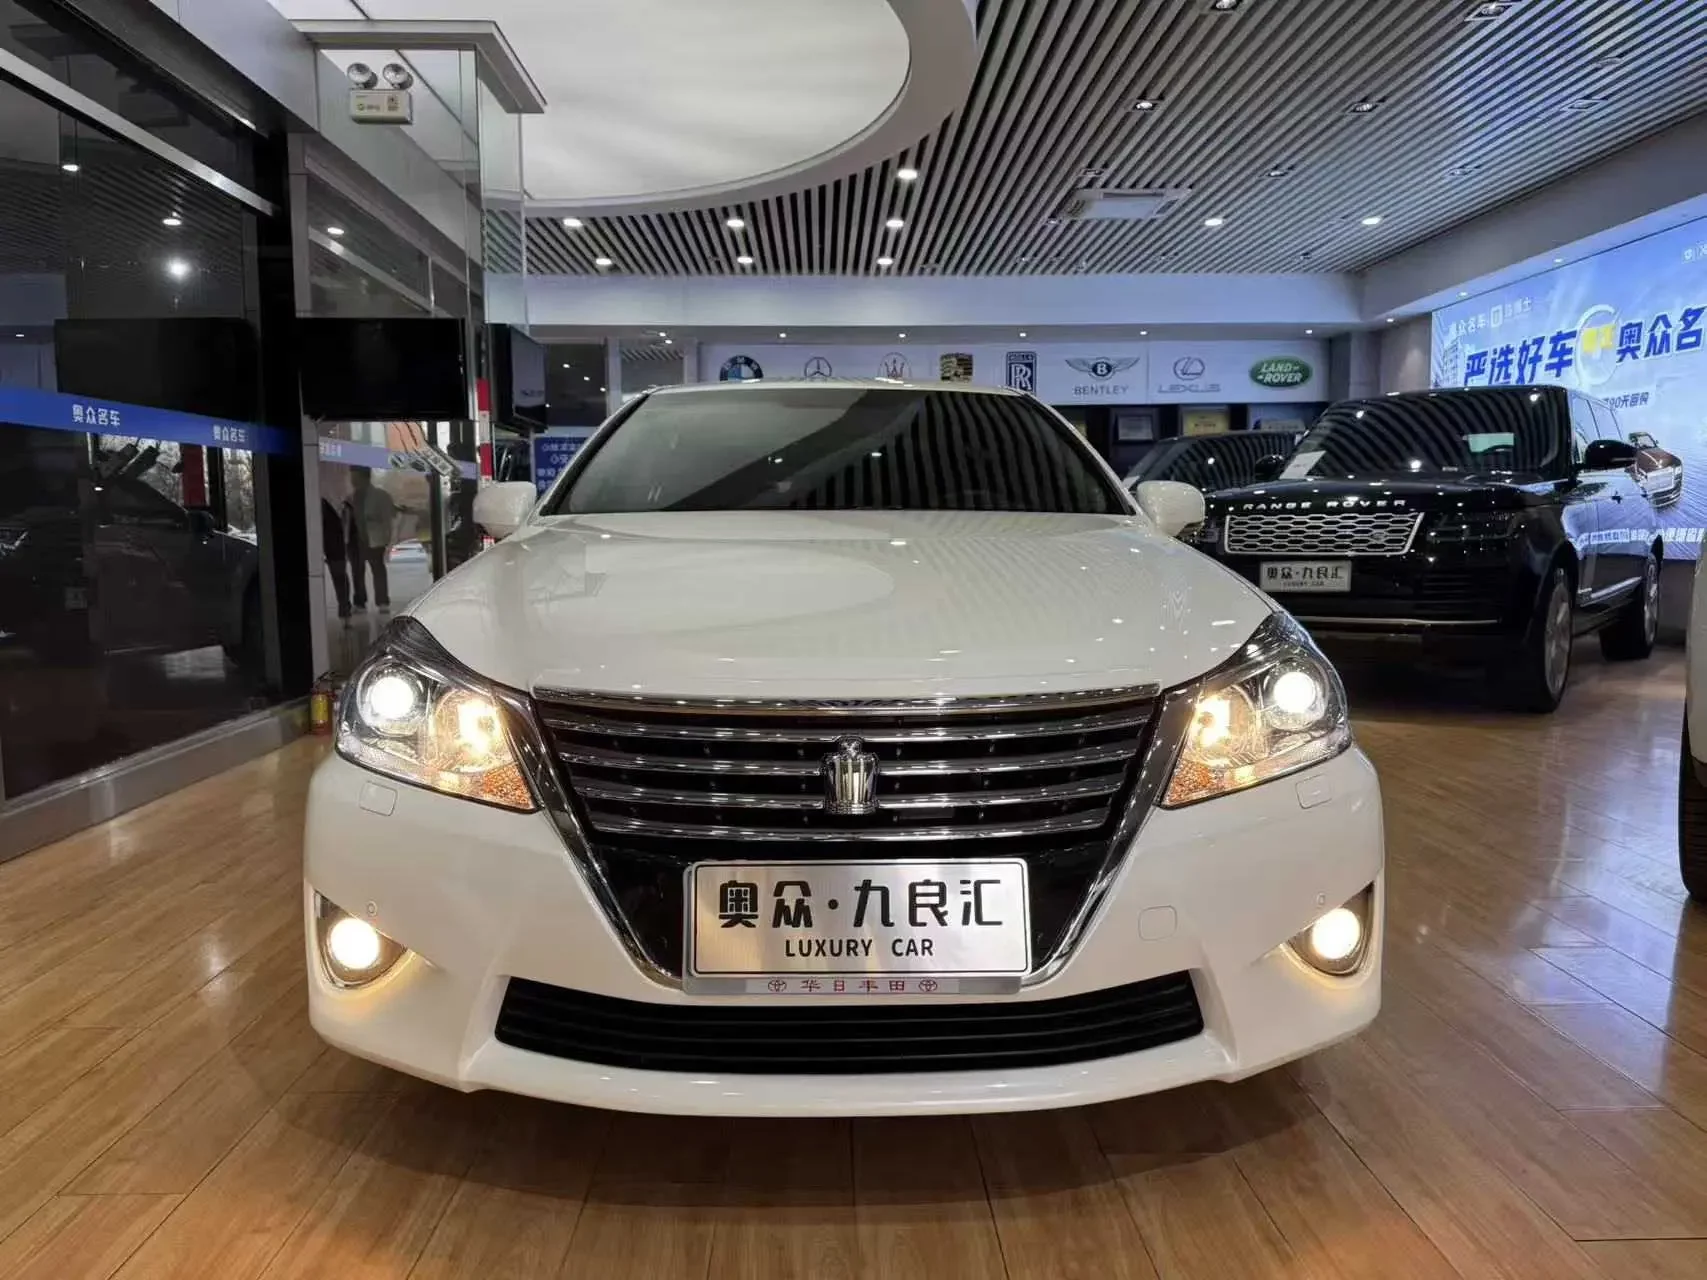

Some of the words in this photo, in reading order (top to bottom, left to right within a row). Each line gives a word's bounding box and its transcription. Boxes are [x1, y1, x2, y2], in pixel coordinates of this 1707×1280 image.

[1616, 306, 1707, 363] 奥众名
[1464, 328, 1578, 384] 严选好车
[1073, 384, 1128, 396] BENTLEY
[1157, 383, 1222, 393] LEXUS
[71, 403, 121, 427] 奥众名车
[1243, 502, 1312, 510] RANGE
[1326, 500, 1407, 508] ROVER
[718, 879, 1003, 928] 奥众·九良汇
[785, 939, 873, 958] LUXURY
[891, 938, 935, 958] CAR
